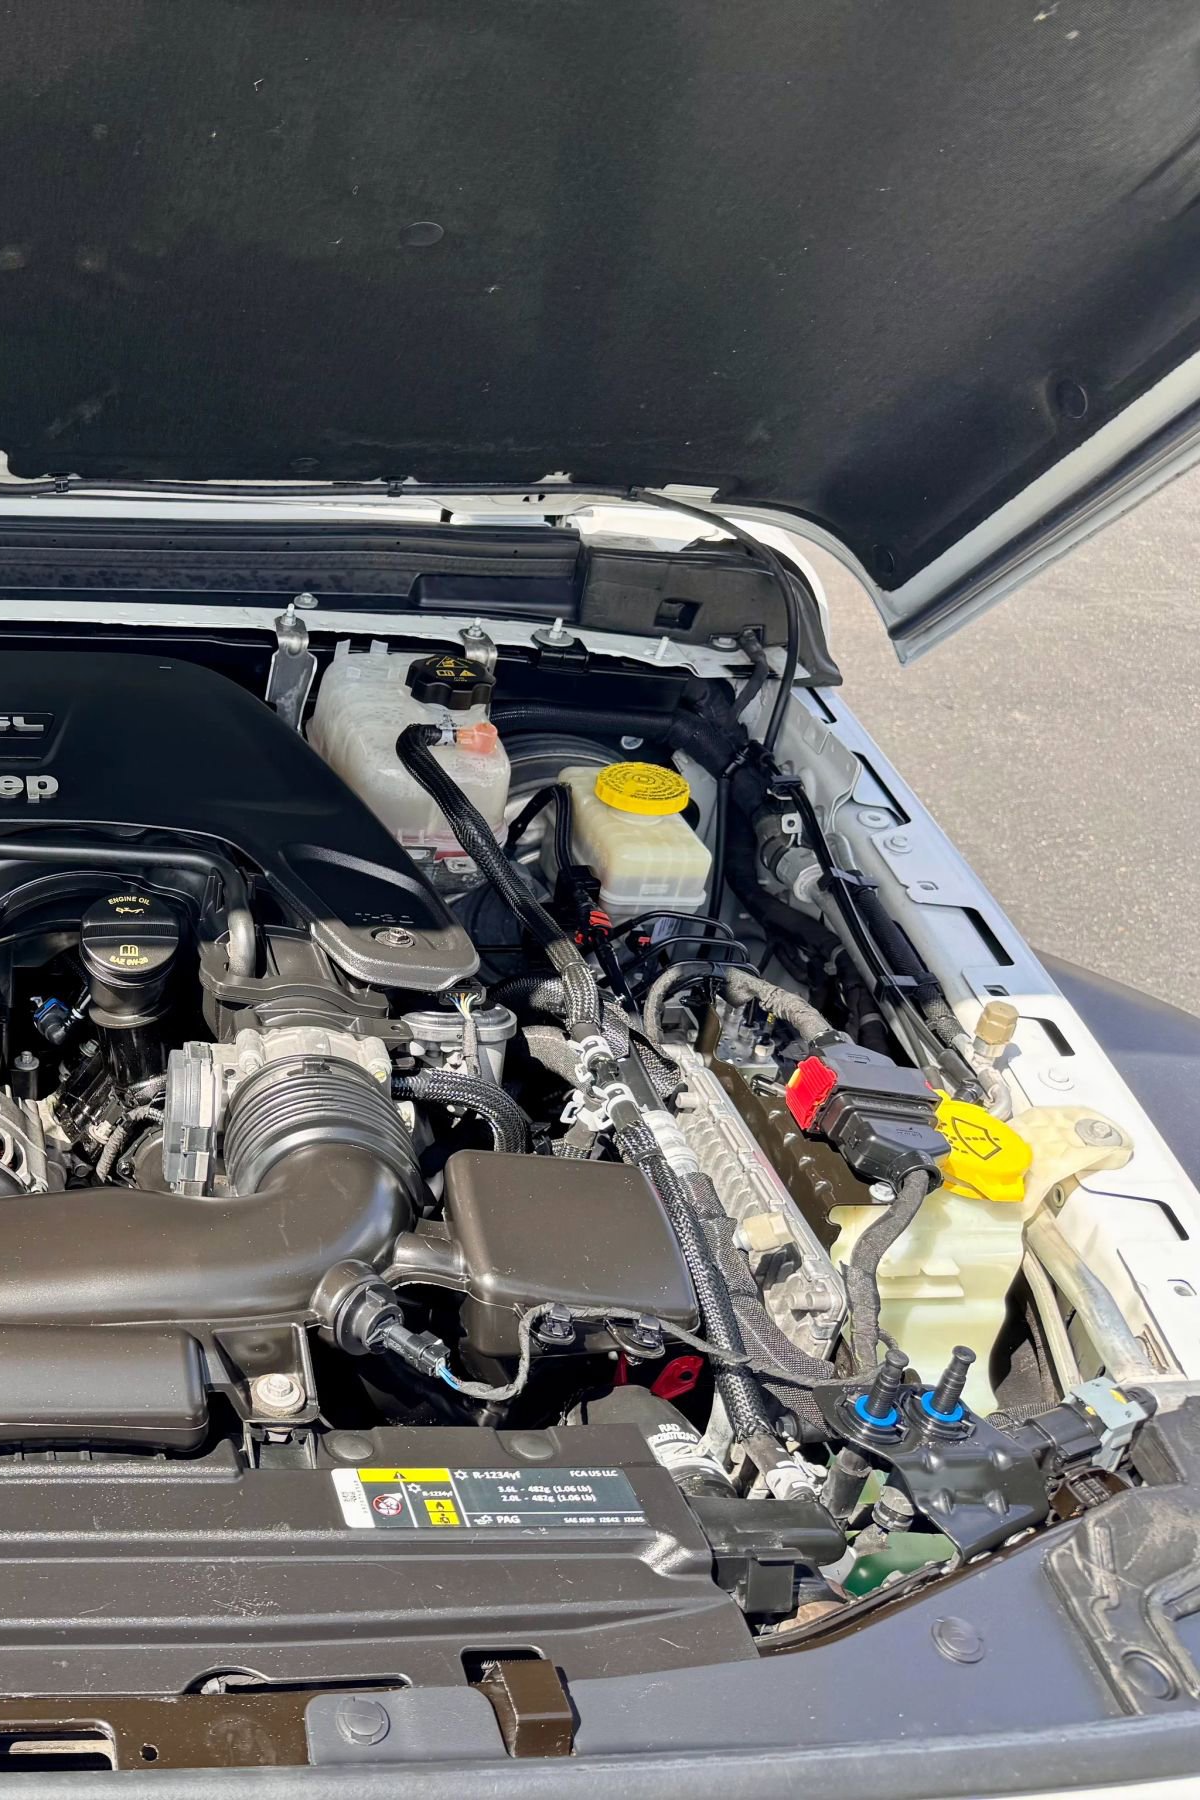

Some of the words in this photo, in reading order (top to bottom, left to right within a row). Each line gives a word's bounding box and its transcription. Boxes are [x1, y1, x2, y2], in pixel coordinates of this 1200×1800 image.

[107, 896, 137, 905] ENGINE
[138, 897, 151, 906] OIL
[109, 955, 126, 965] SAE
[657, 1423, 681, 1433] RAD
[473, 1470, 521, 1481] R-1234yf
[570, 1470, 588, 1478] FCA
[589, 1470, 601, 1478] US
[602, 1470, 619, 1478] LLC
[497, 1485, 518, 1493] 3.6L
[527, 1485, 551, 1494] 482g
[553, 1485, 576, 1494] (1.06
[501, 1494, 522, 1502] 2.0L
[531, 1494, 556, 1503] 482g
[557, 1494, 580, 1503] (1.06
[496, 1515, 521, 1524] PAG
